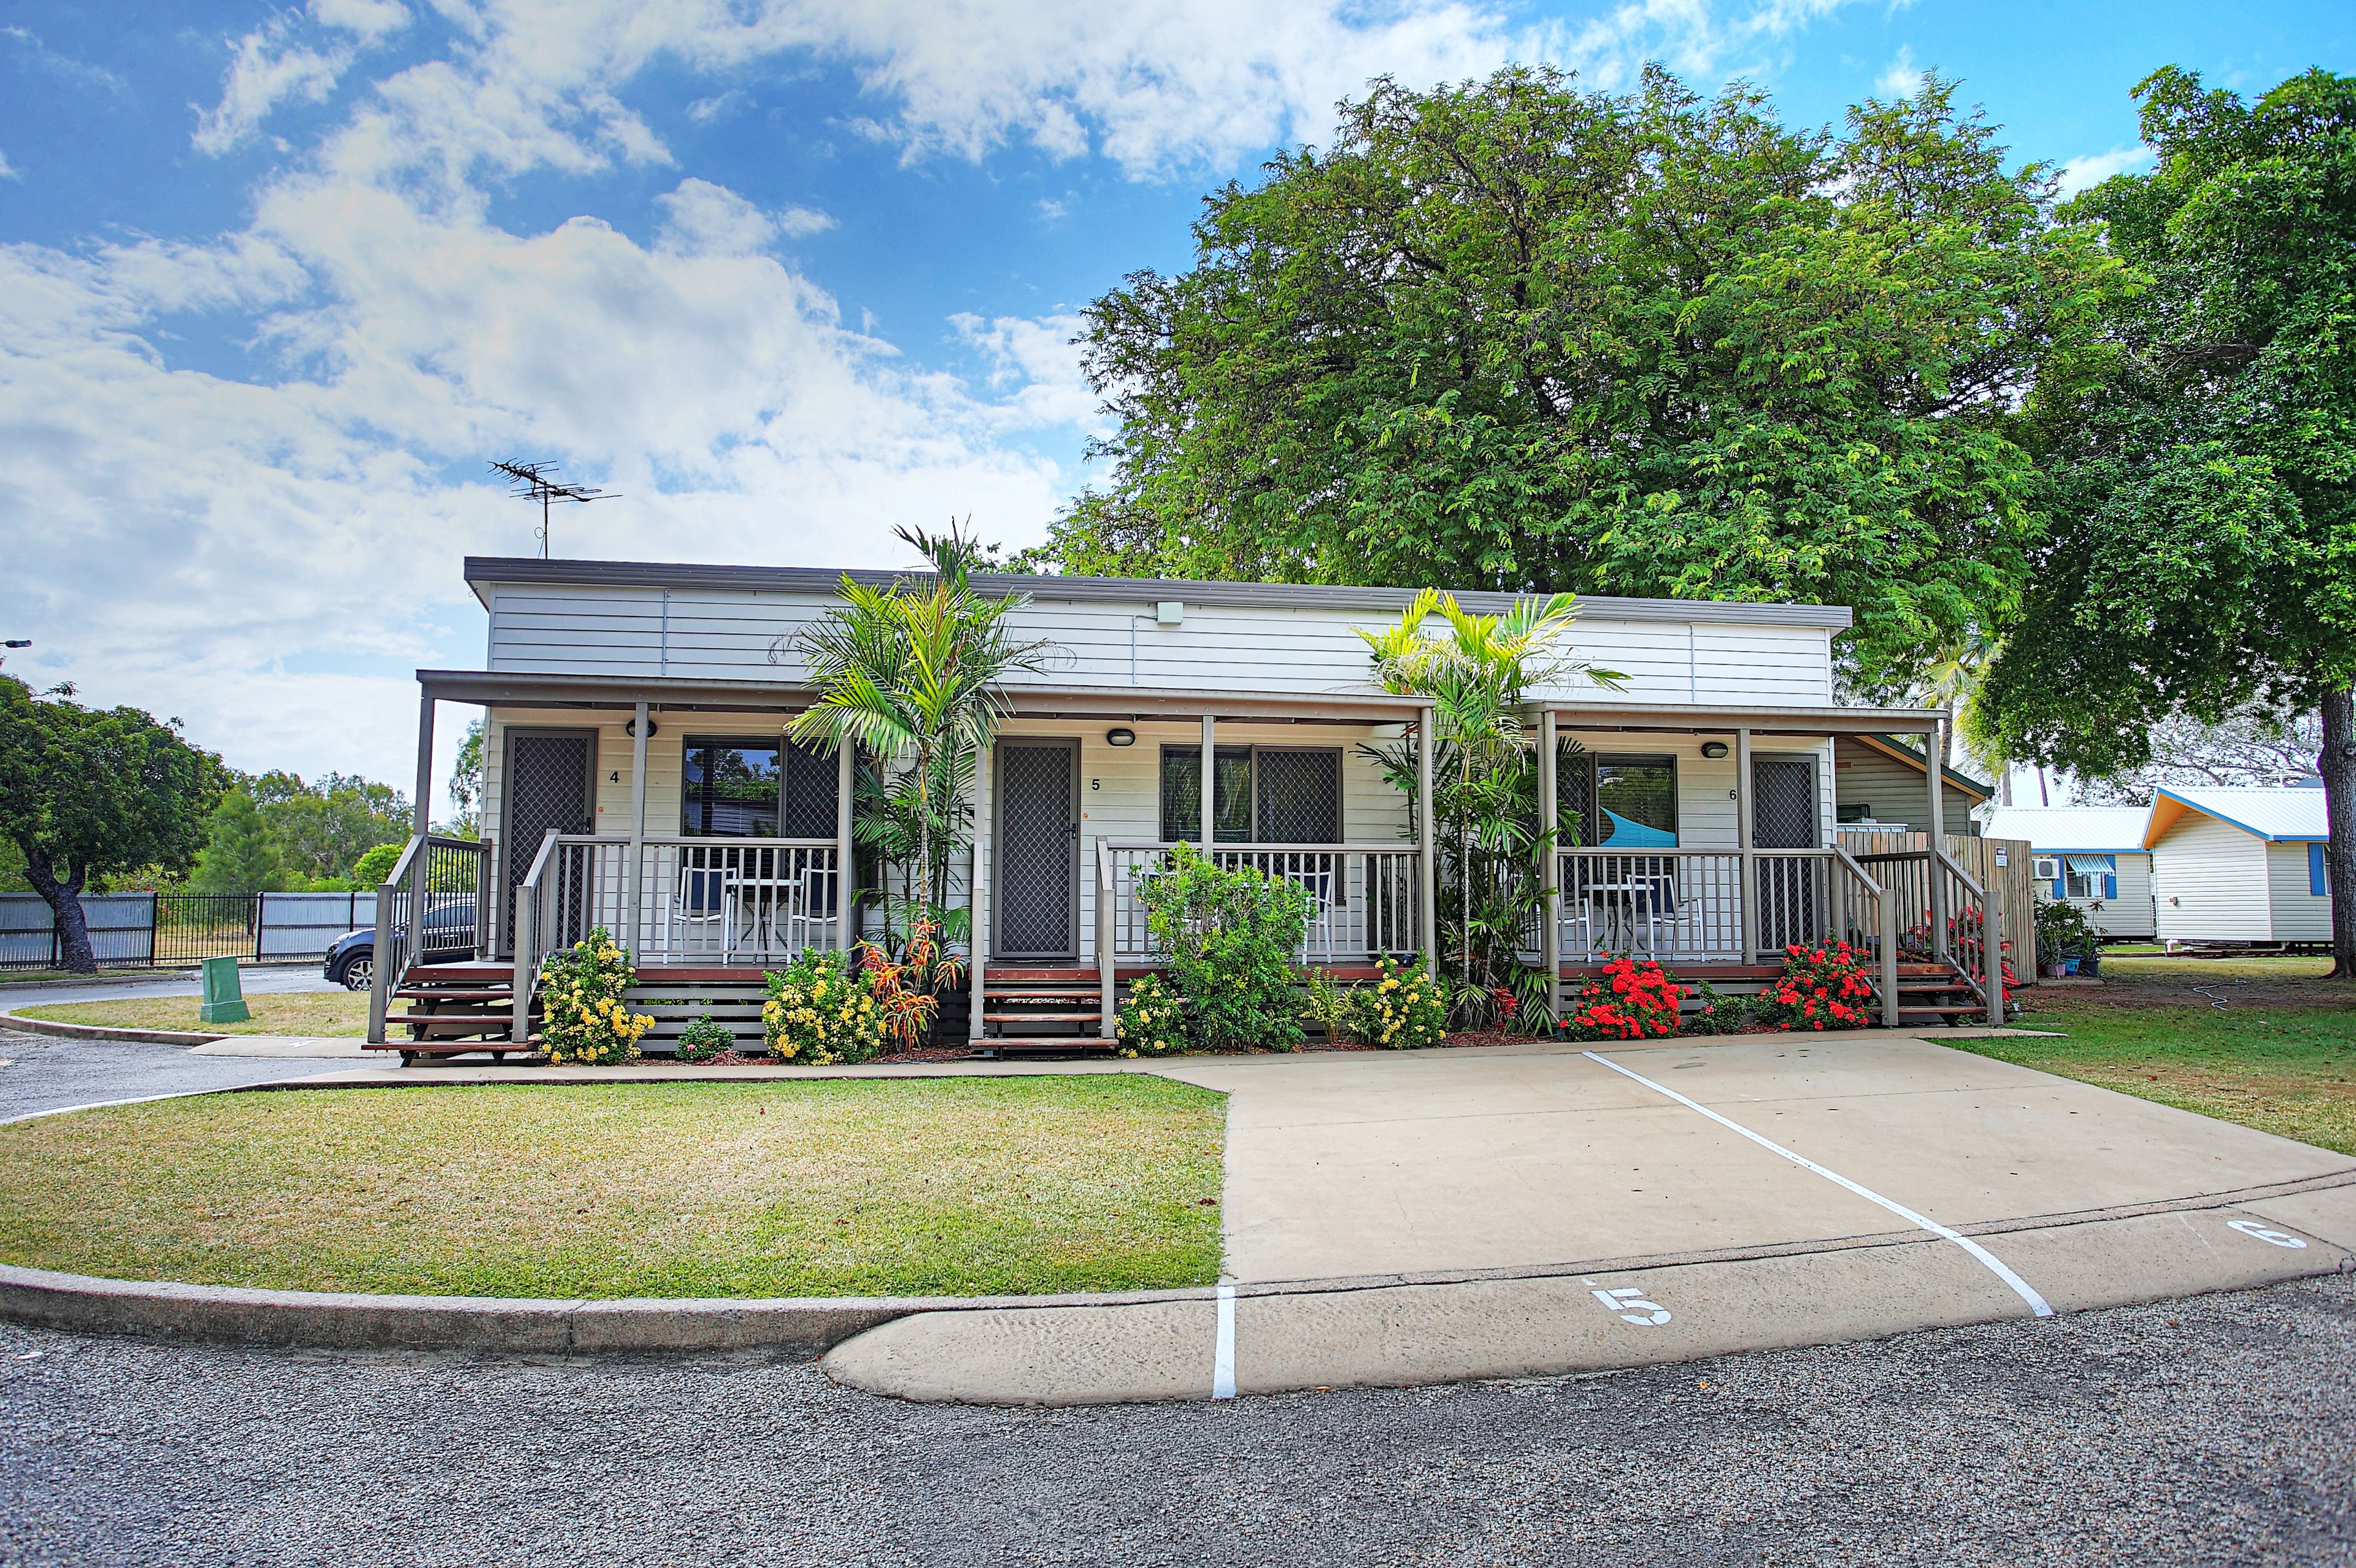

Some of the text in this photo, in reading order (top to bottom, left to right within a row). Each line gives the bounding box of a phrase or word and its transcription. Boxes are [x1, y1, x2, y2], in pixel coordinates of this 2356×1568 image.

[610, 771, 619, 783] 4
[1092, 779, 1100, 791] 5
[1730, 790, 1737, 800] 6
[2227, 1220, 2308, 1249] 6
[1591, 1288, 1672, 1326] 5
